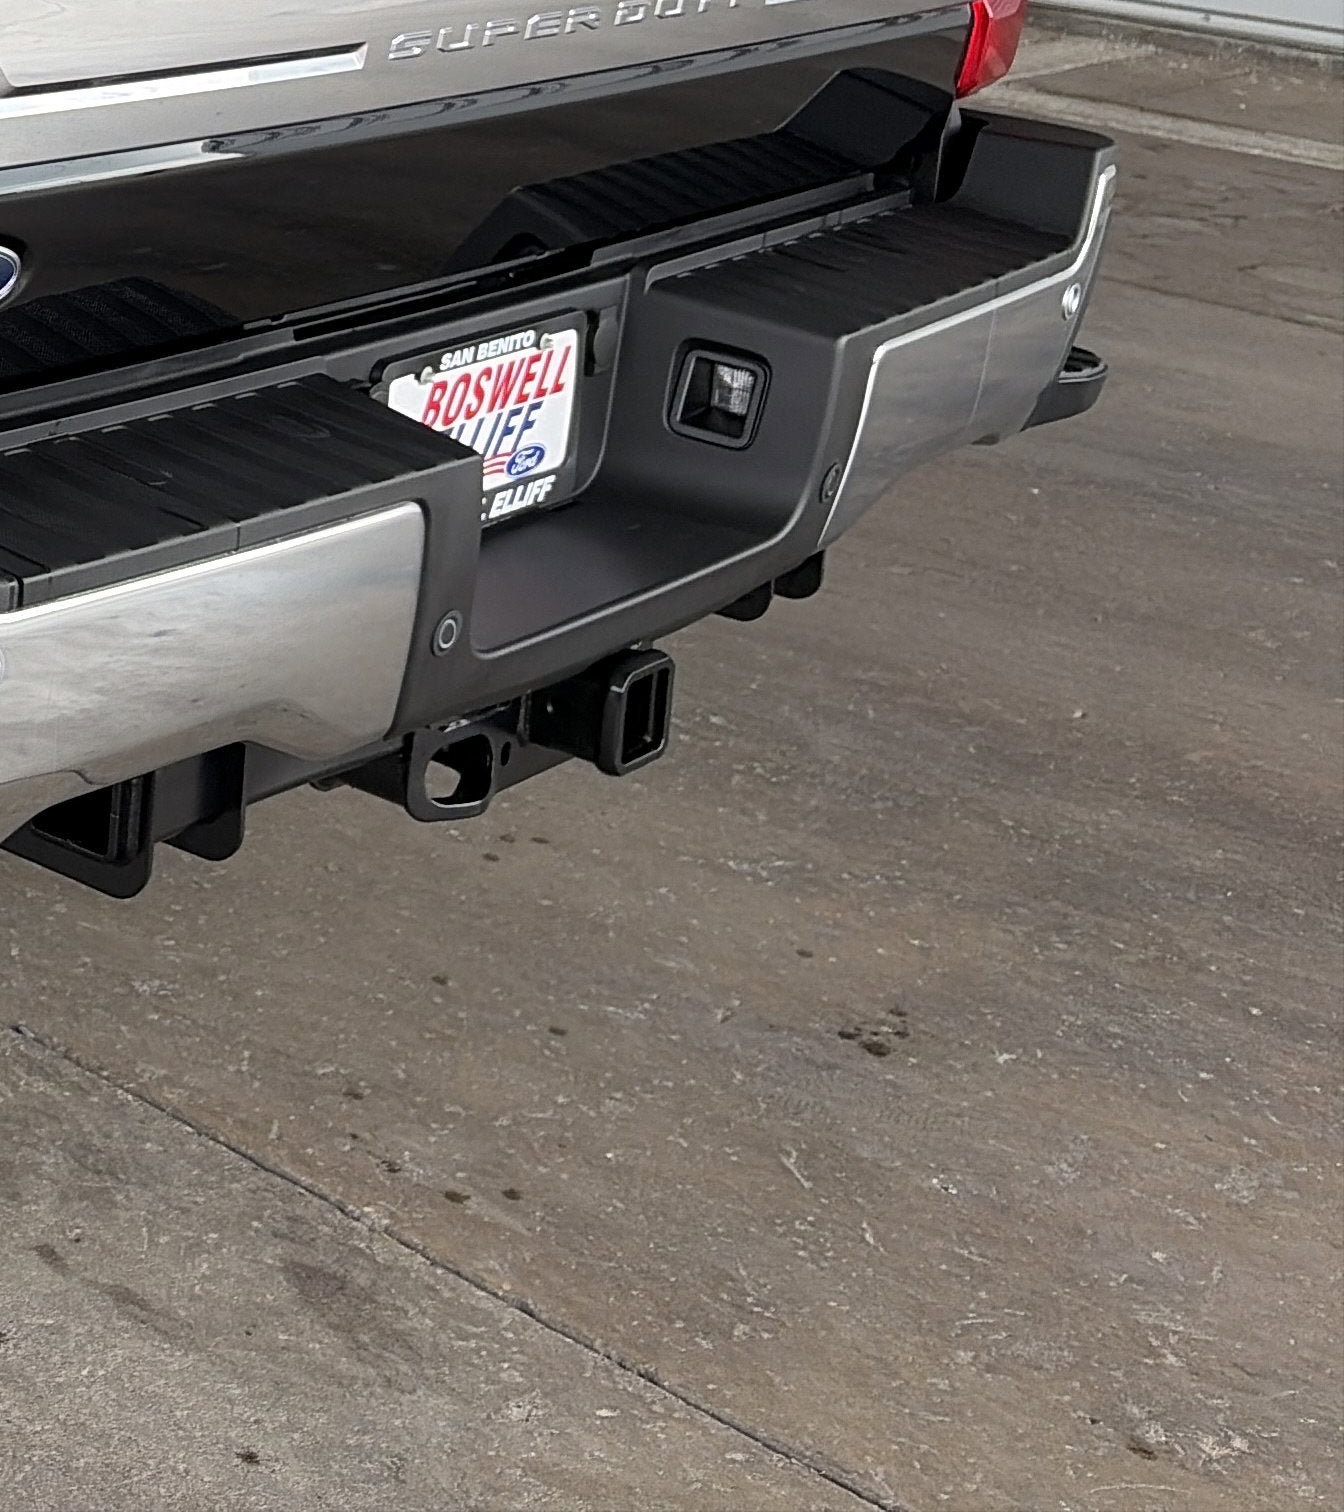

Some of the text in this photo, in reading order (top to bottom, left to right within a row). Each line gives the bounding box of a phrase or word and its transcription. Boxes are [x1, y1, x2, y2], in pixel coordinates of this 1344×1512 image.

[387, 7, 602, 62] SUPER
[439, 330, 536, 371] SAN BENITO
[421, 345, 572, 428] BOSWELL
[488, 474, 556, 520] ELLIFF
